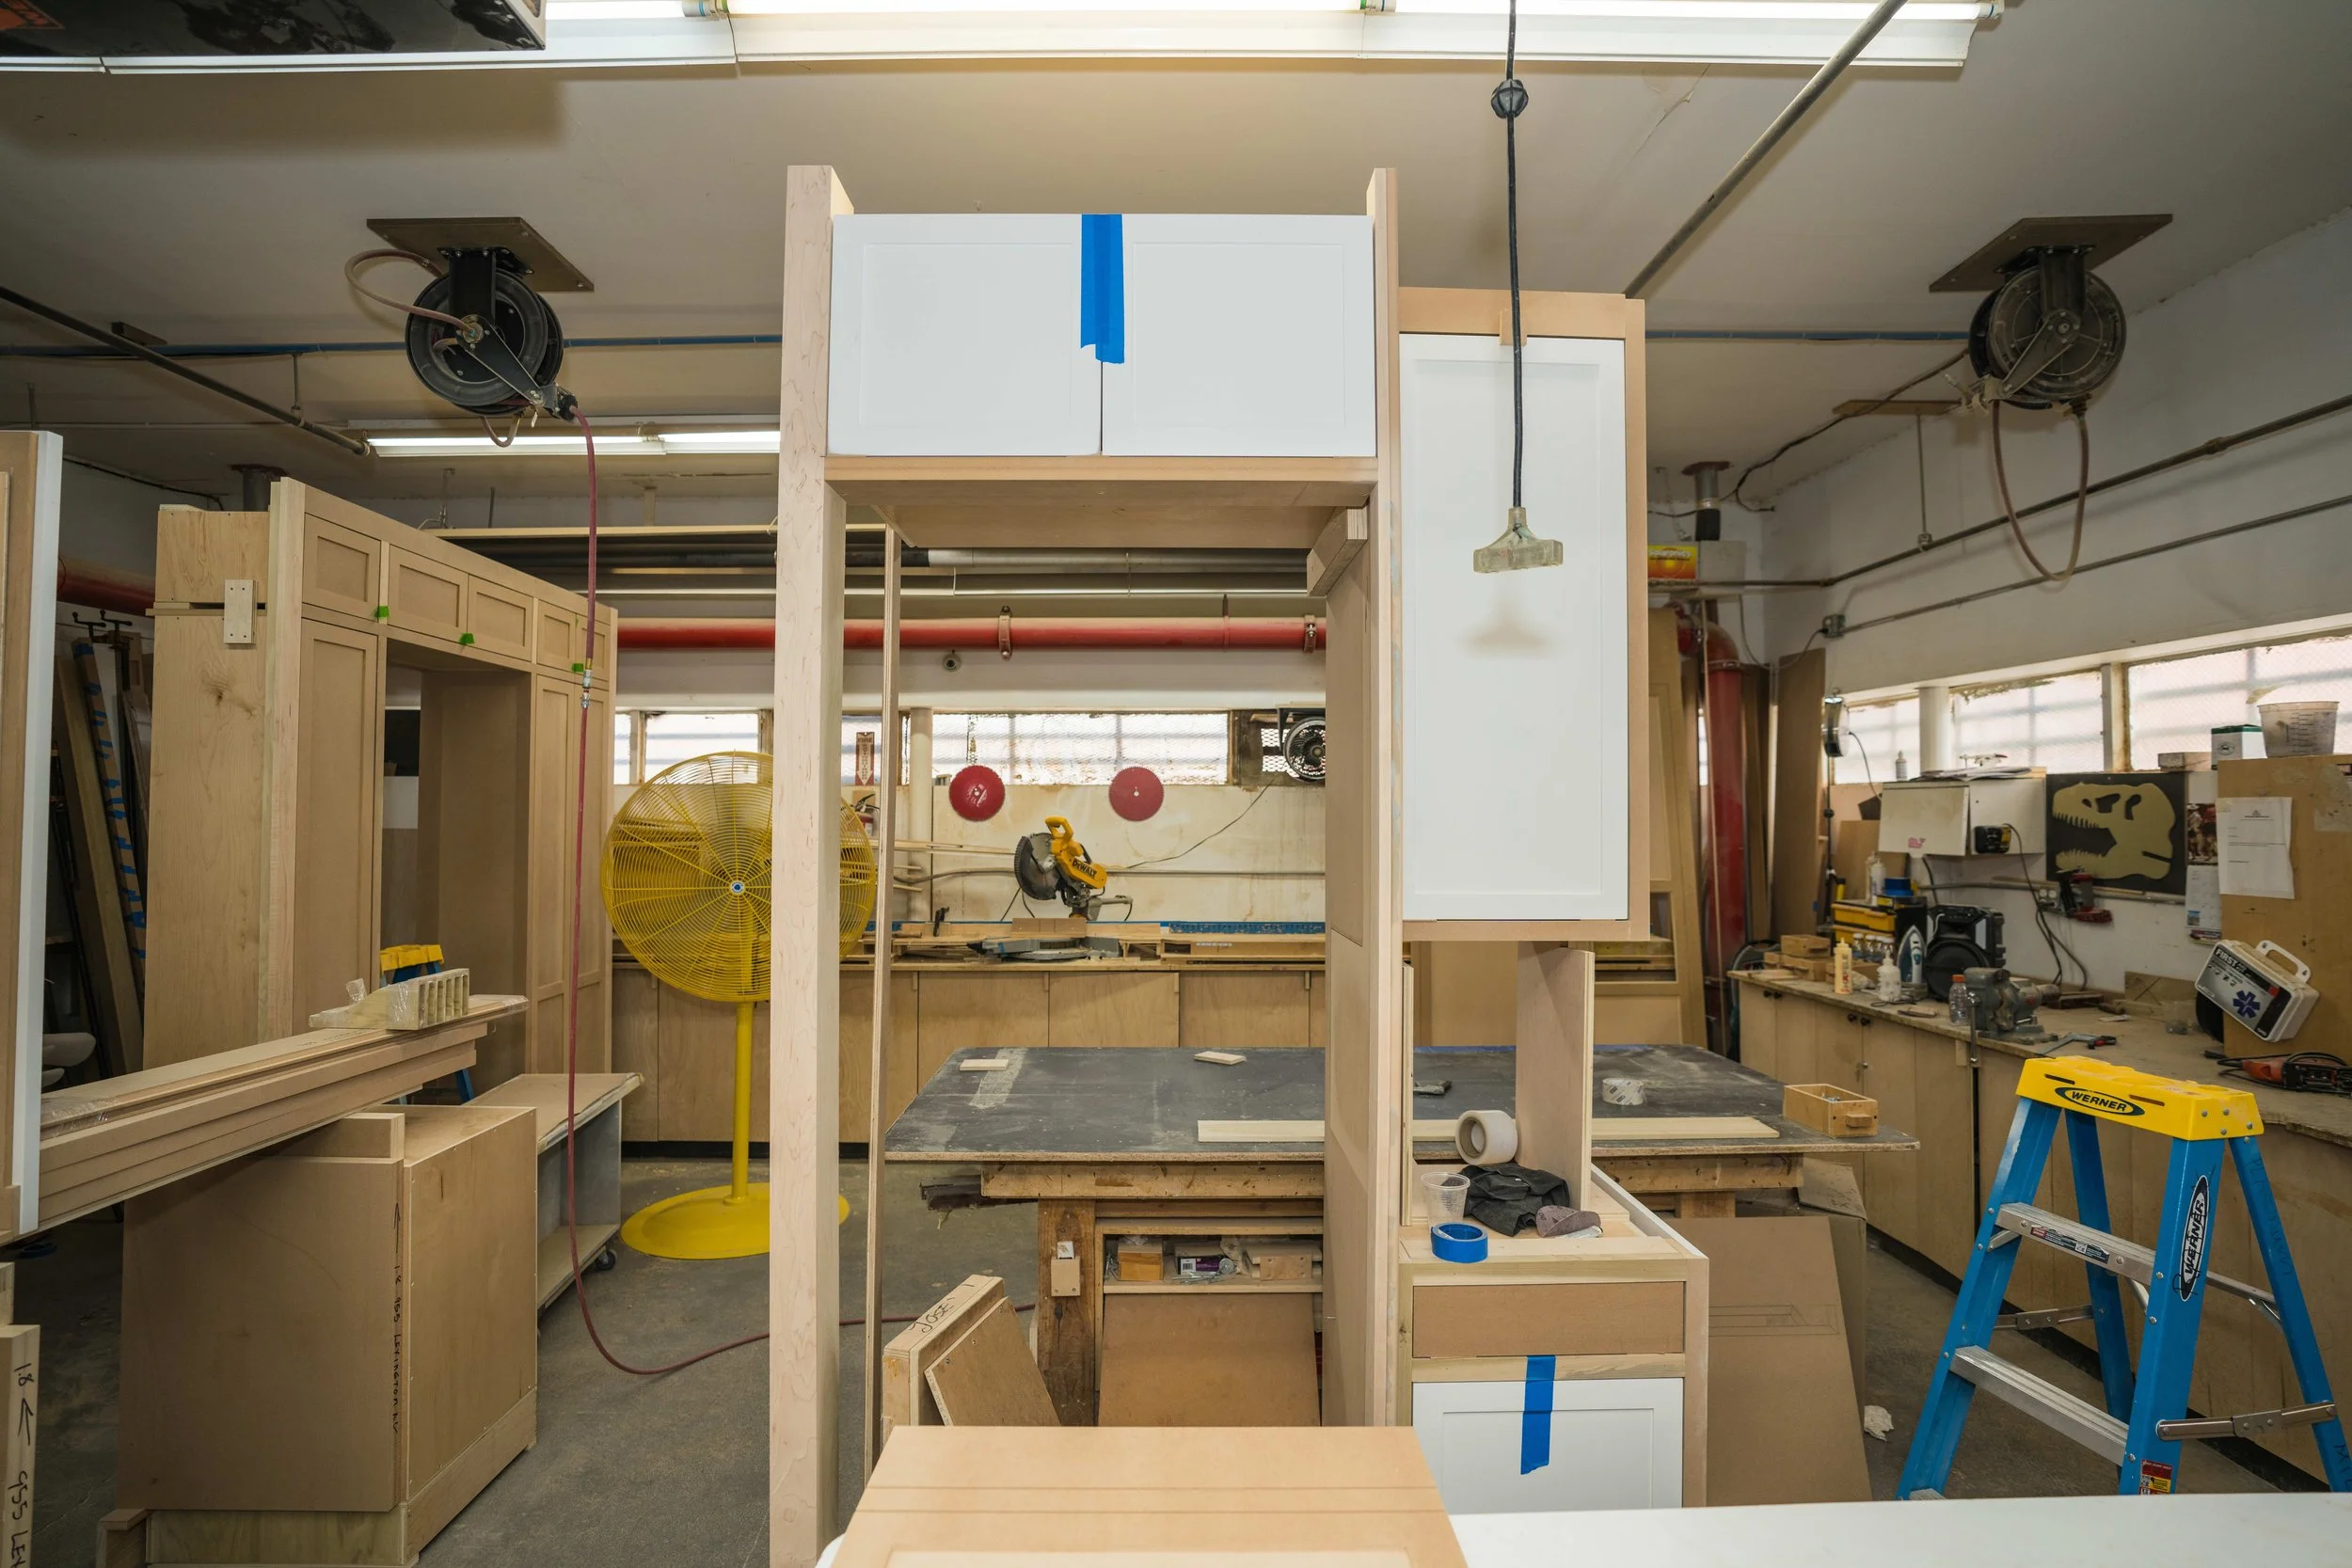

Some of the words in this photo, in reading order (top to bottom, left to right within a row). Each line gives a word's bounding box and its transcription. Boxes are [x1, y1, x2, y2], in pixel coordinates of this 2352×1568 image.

[2215, 948, 2238, 968] FIRST
[2072, 1091, 2127, 1111] WERNER
[2185, 1199, 2204, 1275] WERNER
[393, 1297, 402, 1323] 955
[13, 1362, 35, 1386] 1.8
[8, 1470, 28, 1521] 955
